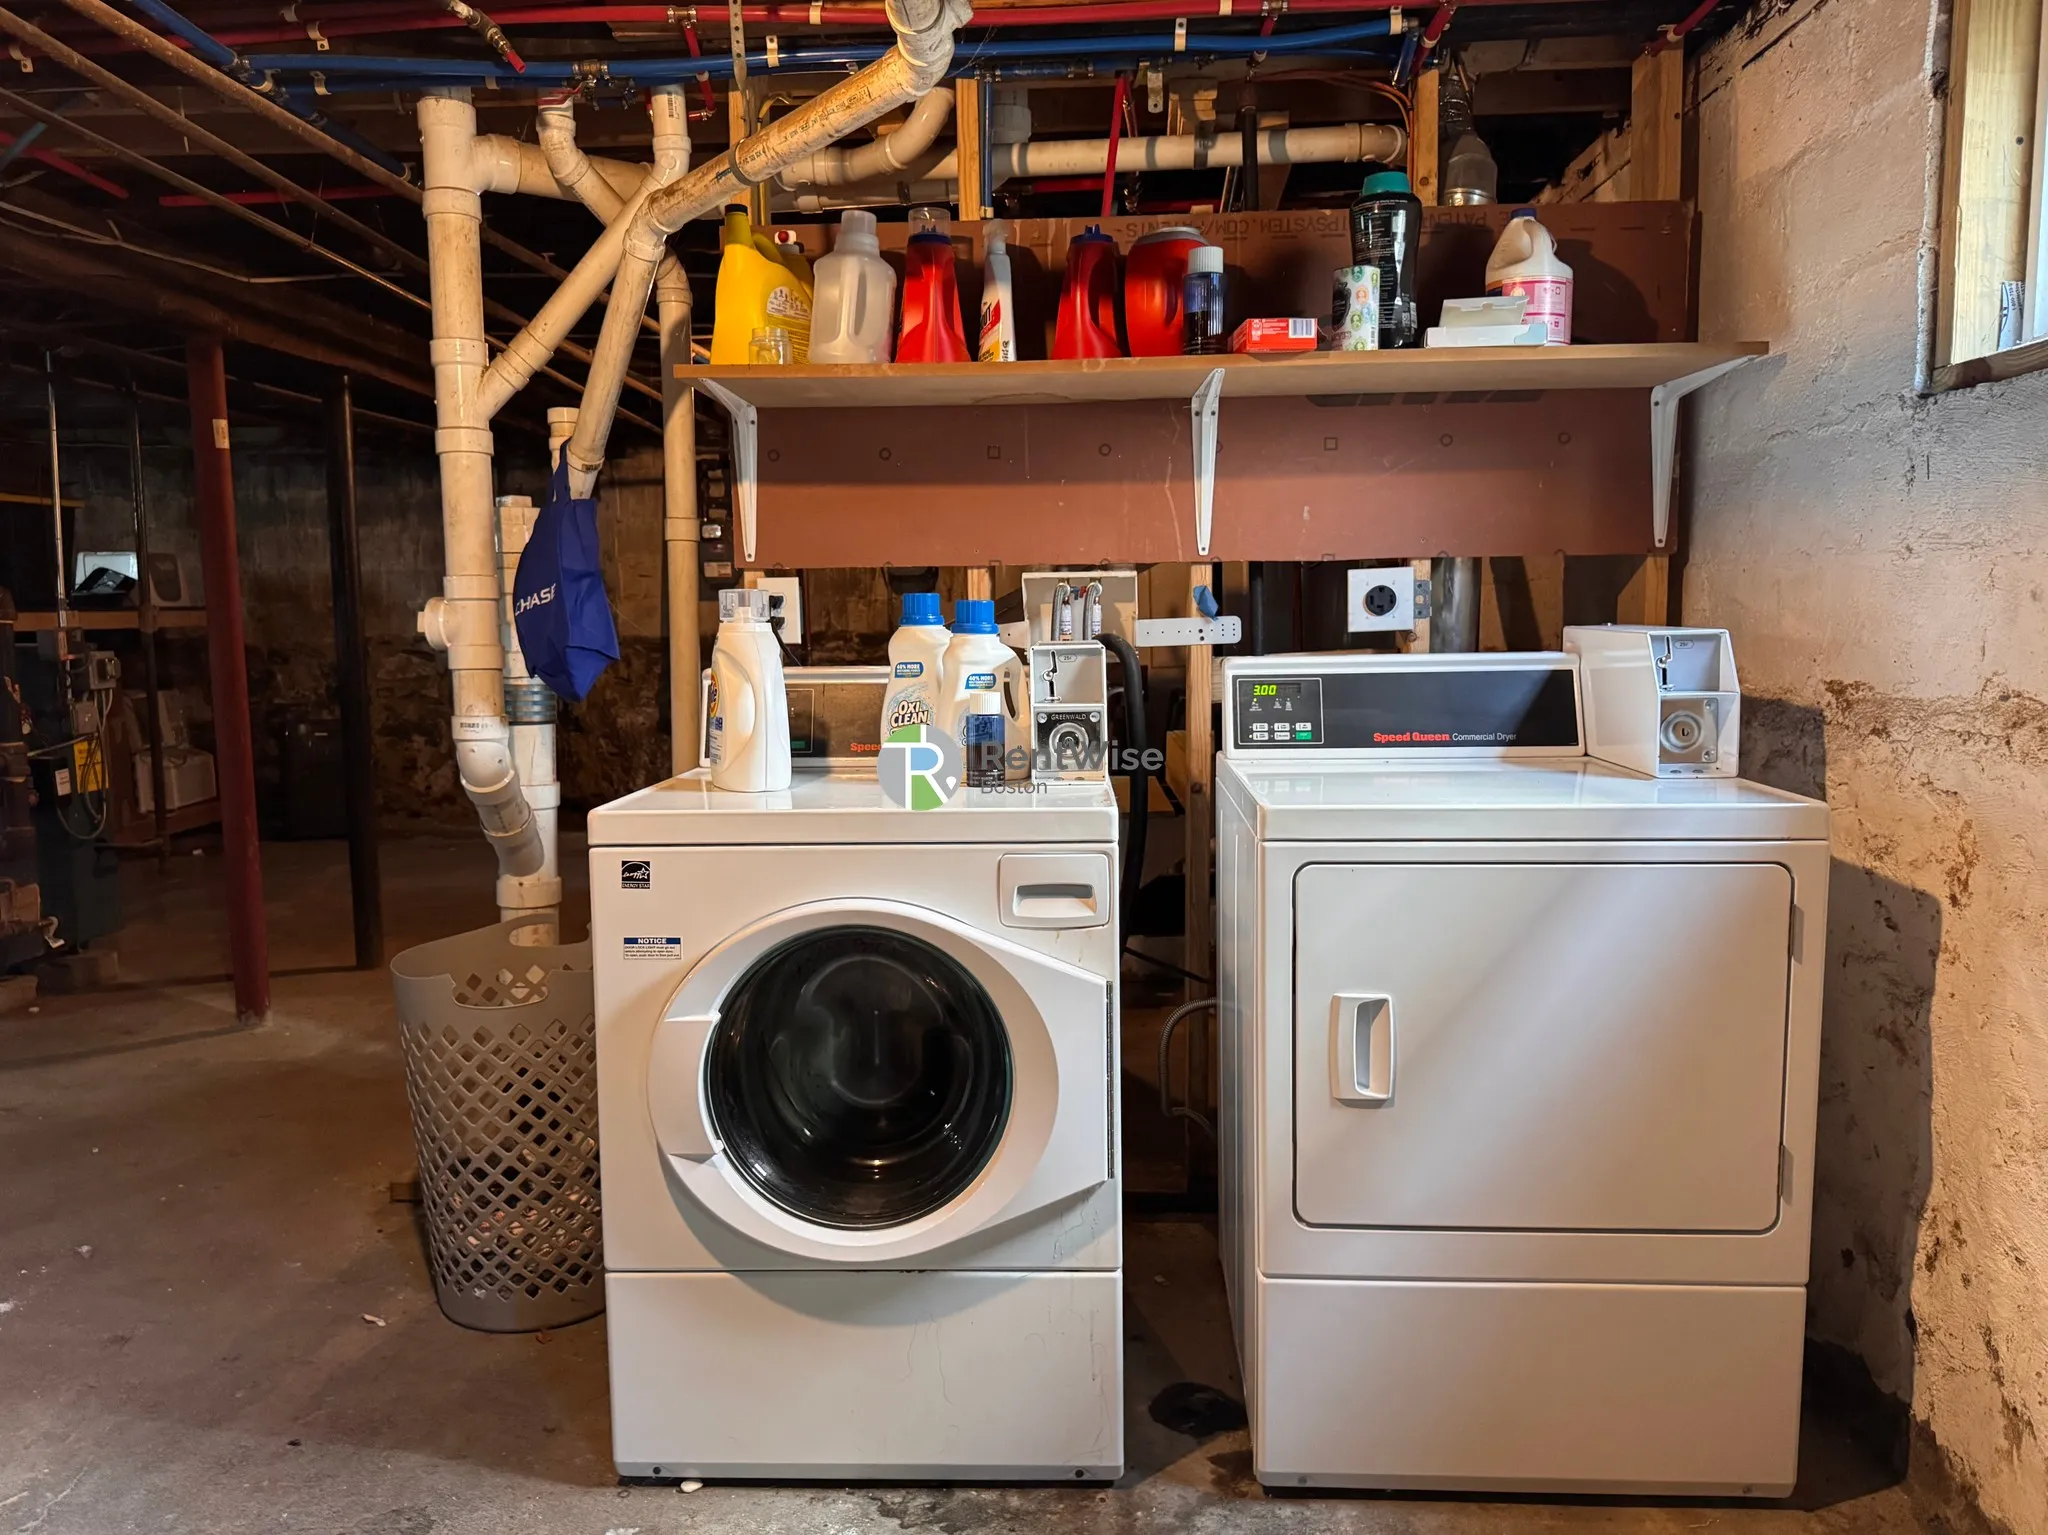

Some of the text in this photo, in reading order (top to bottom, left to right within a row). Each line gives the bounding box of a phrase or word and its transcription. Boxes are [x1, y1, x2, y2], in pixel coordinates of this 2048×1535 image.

[898, 699, 921, 715] OXI
[1373, 732, 1517, 743] Speed Queen Commercial Dryer
[850, 742, 882, 752] Spee
